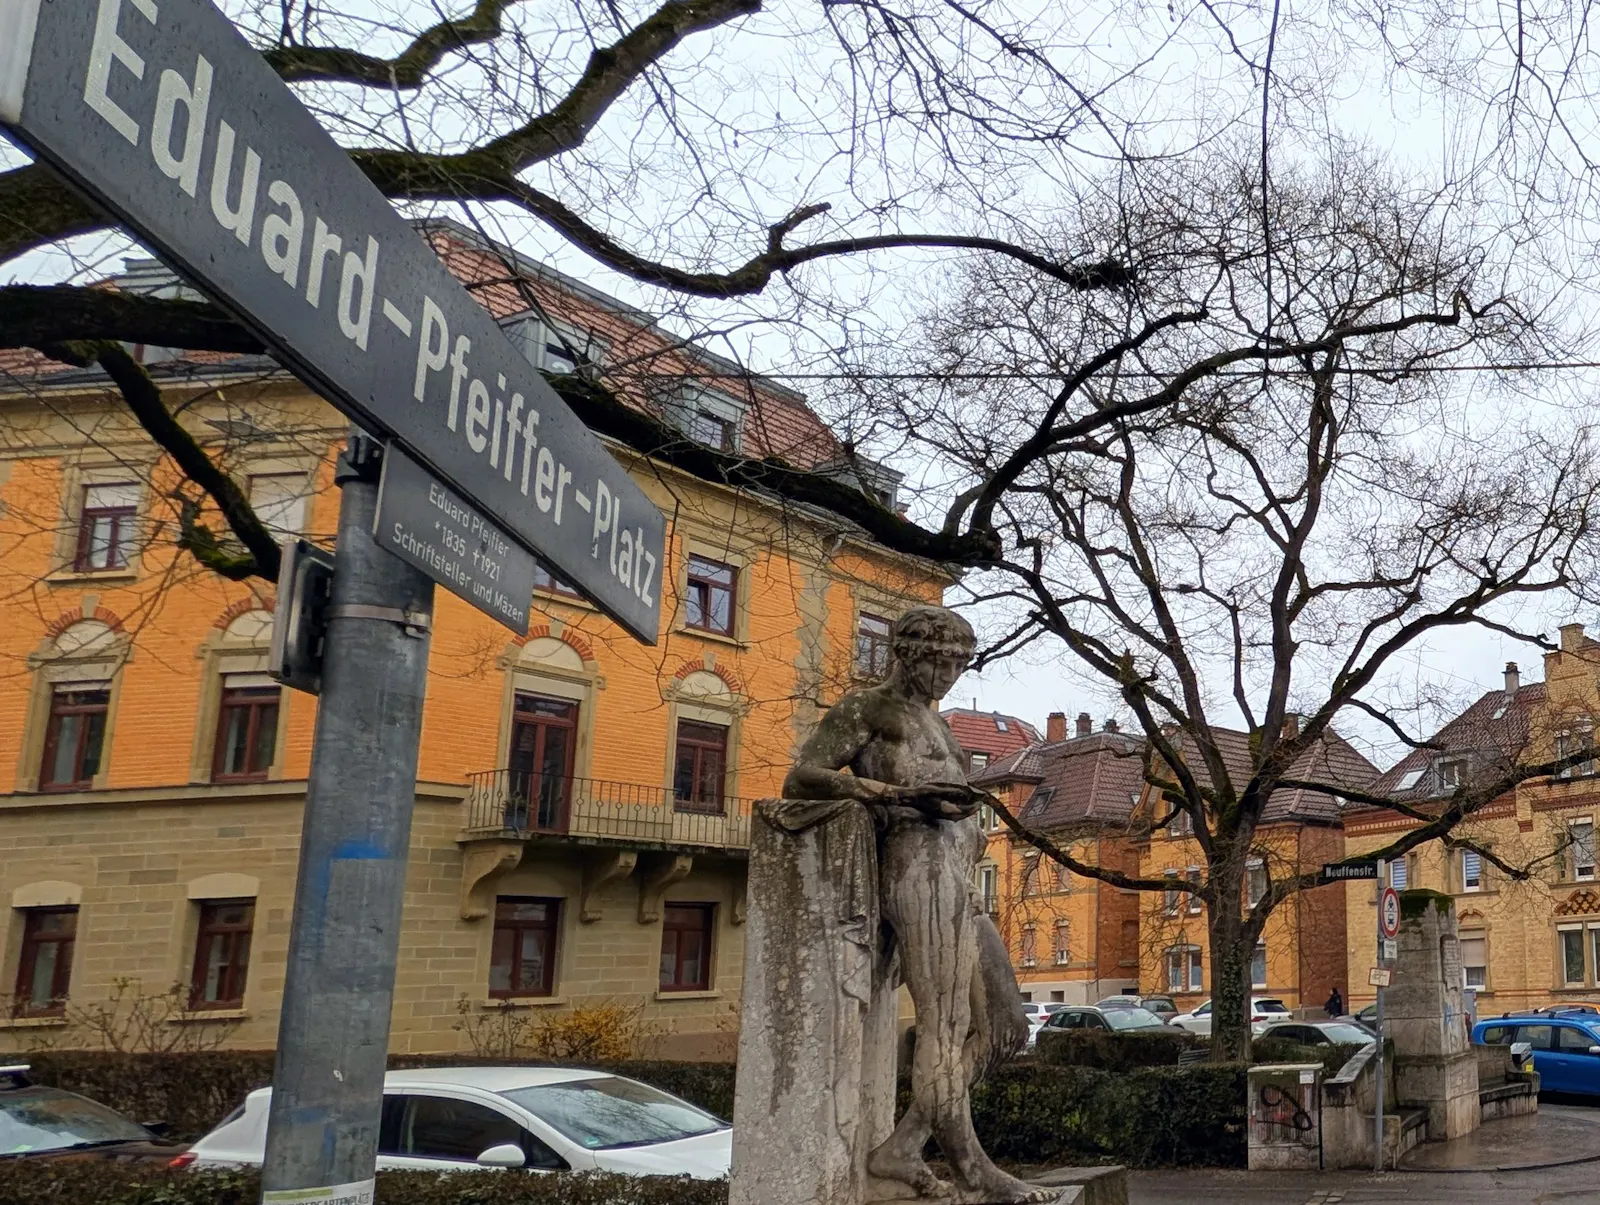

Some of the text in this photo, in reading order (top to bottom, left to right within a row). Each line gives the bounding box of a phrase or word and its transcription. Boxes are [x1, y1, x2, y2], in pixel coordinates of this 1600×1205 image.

[83, 0, 657, 608] Eduard-Pfeiffer-Platz
[428, 483, 510, 558] Eduard Pfeiffer
[392, 522, 524, 625] Schriftsteller und Mäzen
